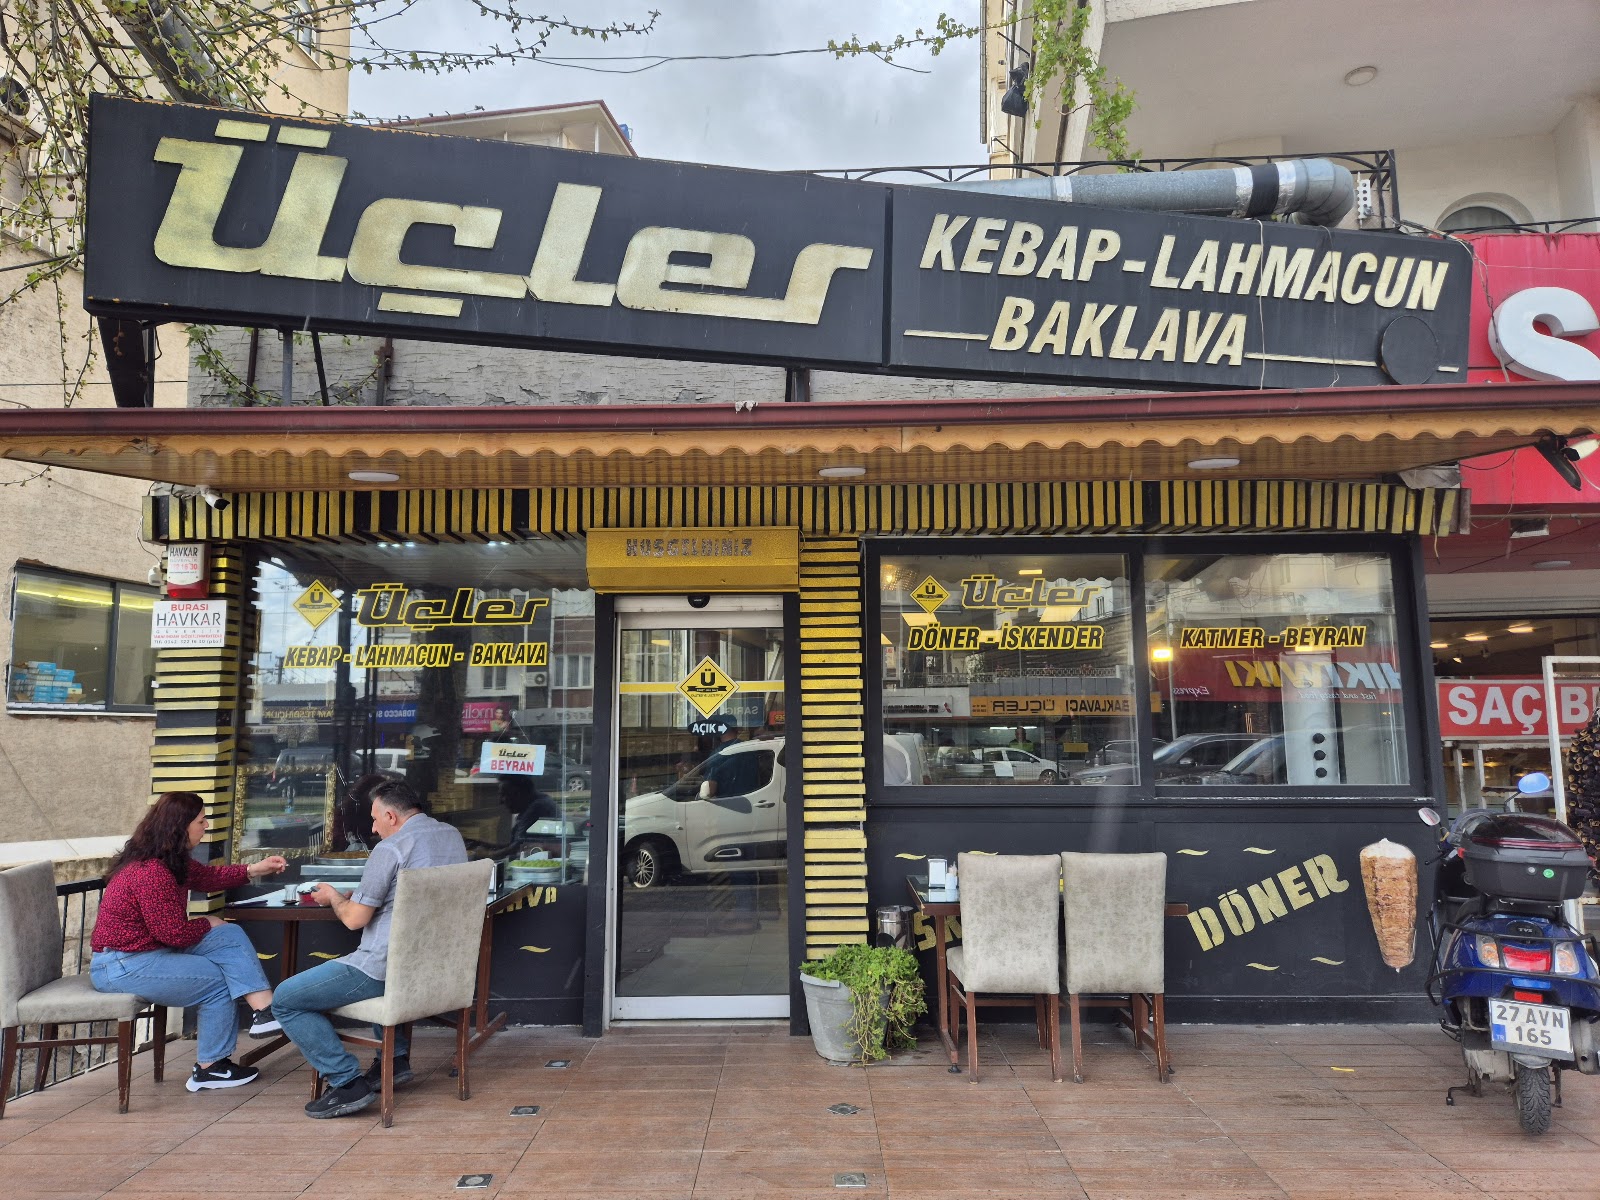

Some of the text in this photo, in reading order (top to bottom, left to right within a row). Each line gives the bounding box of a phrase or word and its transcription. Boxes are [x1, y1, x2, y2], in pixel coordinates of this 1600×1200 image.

[153, 119, 874, 326] Üçler
[988, 296, 1247, 367] BAKLAVA
[169, 547, 199, 557] HAVKAR
[310, 589, 324, 603] Ü
[925, 582, 936, 594] Ü
[961, 574, 1101, 612] Üçler
[171, 603, 209, 611] BURASI
[356, 583, 549, 631] Üçler
[156, 612, 221, 626] HAVKAR
[907, 621, 982, 650] DÖNER
[998, 622, 1105, 650] İSKENDER
[1180, 627, 1265, 648] KATMER
[1284, 625, 1366, 647] BEYRAN
[283, 645, 342, 668] KEBAP
[353, 642, 454, 668] LAHMACUN
[470, 641, 547, 667] BAKLAVA
[700, 668, 716, 686] Ü
[1448, 685, 1542, 735] SAÇ
[692, 722, 717, 736] AÇIK
[490, 760, 534, 772] BEYRAN
[1187, 854, 1350, 952] DÖNER
[1497, 1005, 1564, 1028] 27 AVN
[1515, 1025, 1552, 1045] 165
